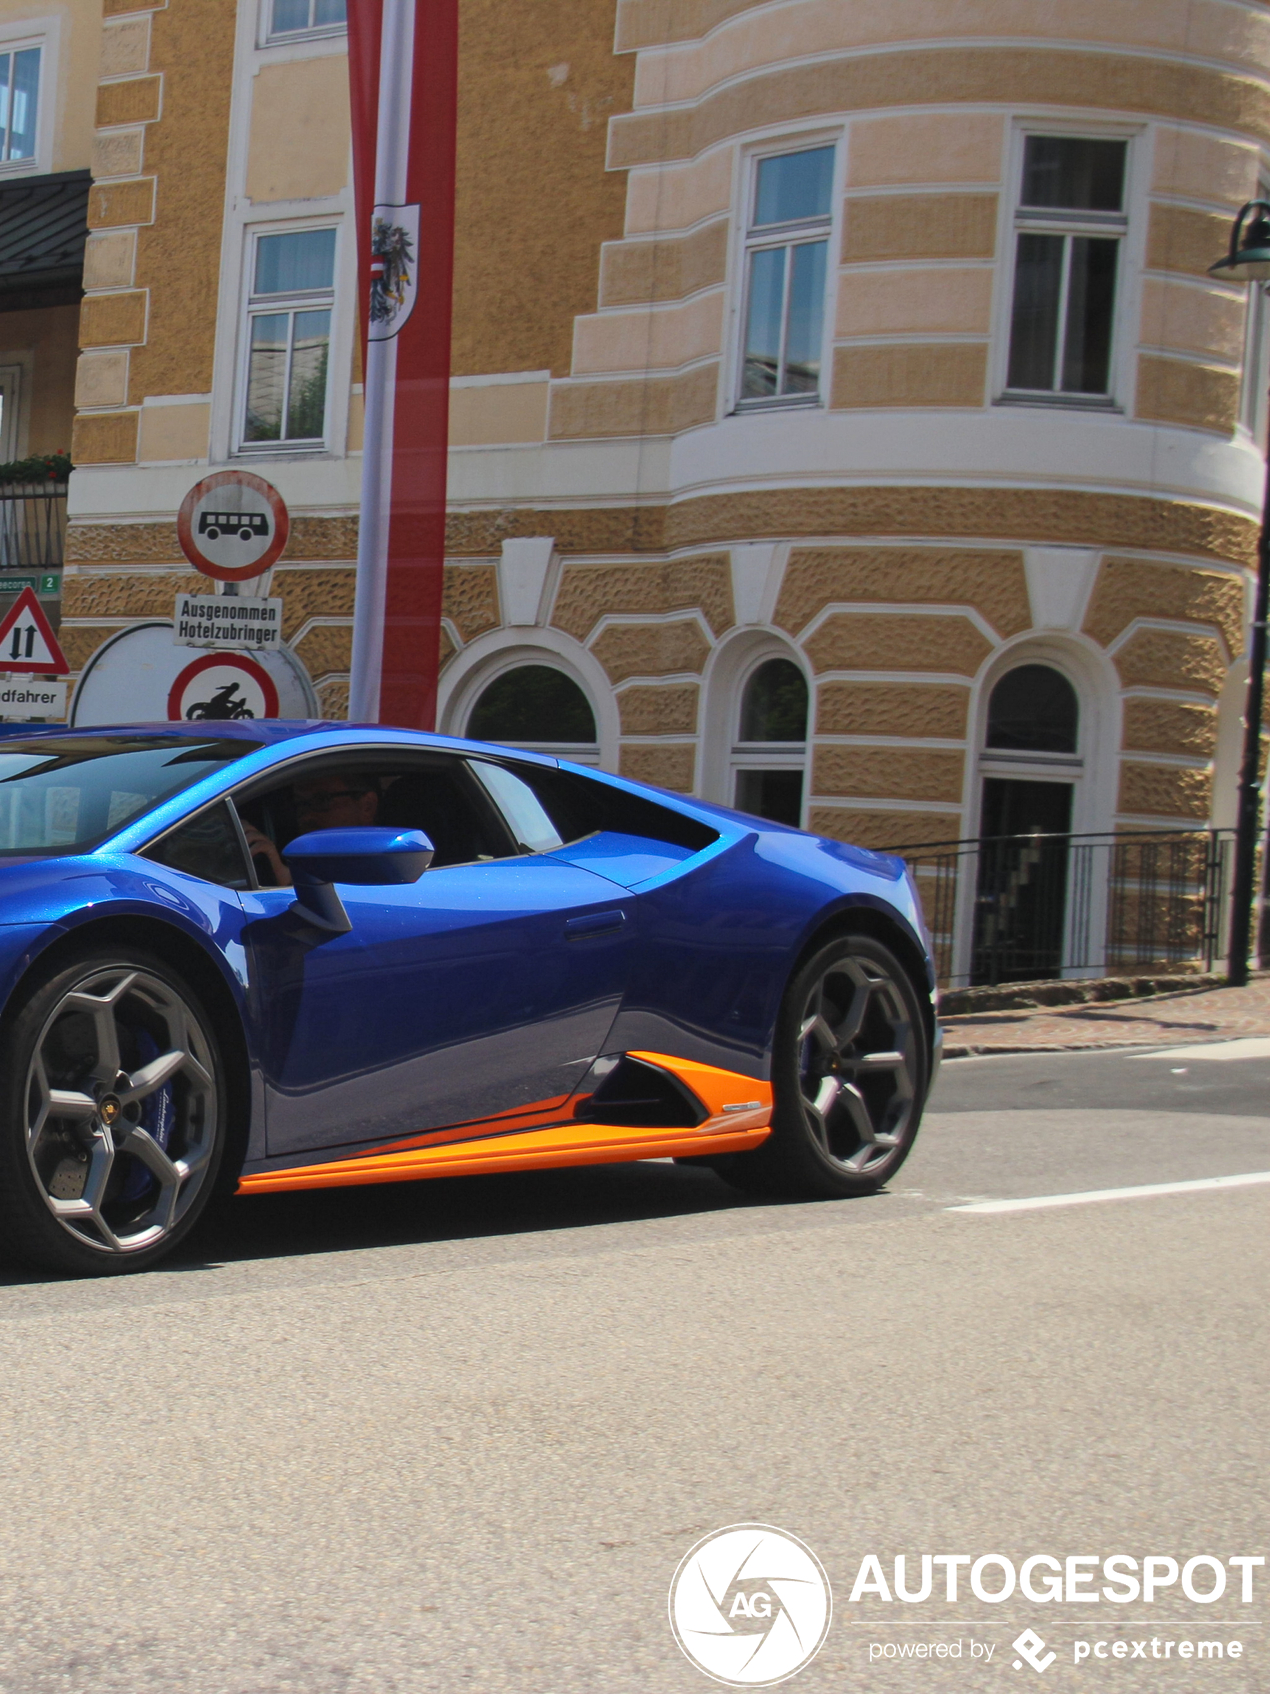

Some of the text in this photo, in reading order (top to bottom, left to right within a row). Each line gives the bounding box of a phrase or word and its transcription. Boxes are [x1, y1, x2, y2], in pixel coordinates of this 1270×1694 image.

[46, 577, 54, 588] 2
[181, 600, 276, 621] Ausgenommen
[179, 621, 278, 645] Hotelzubringer
